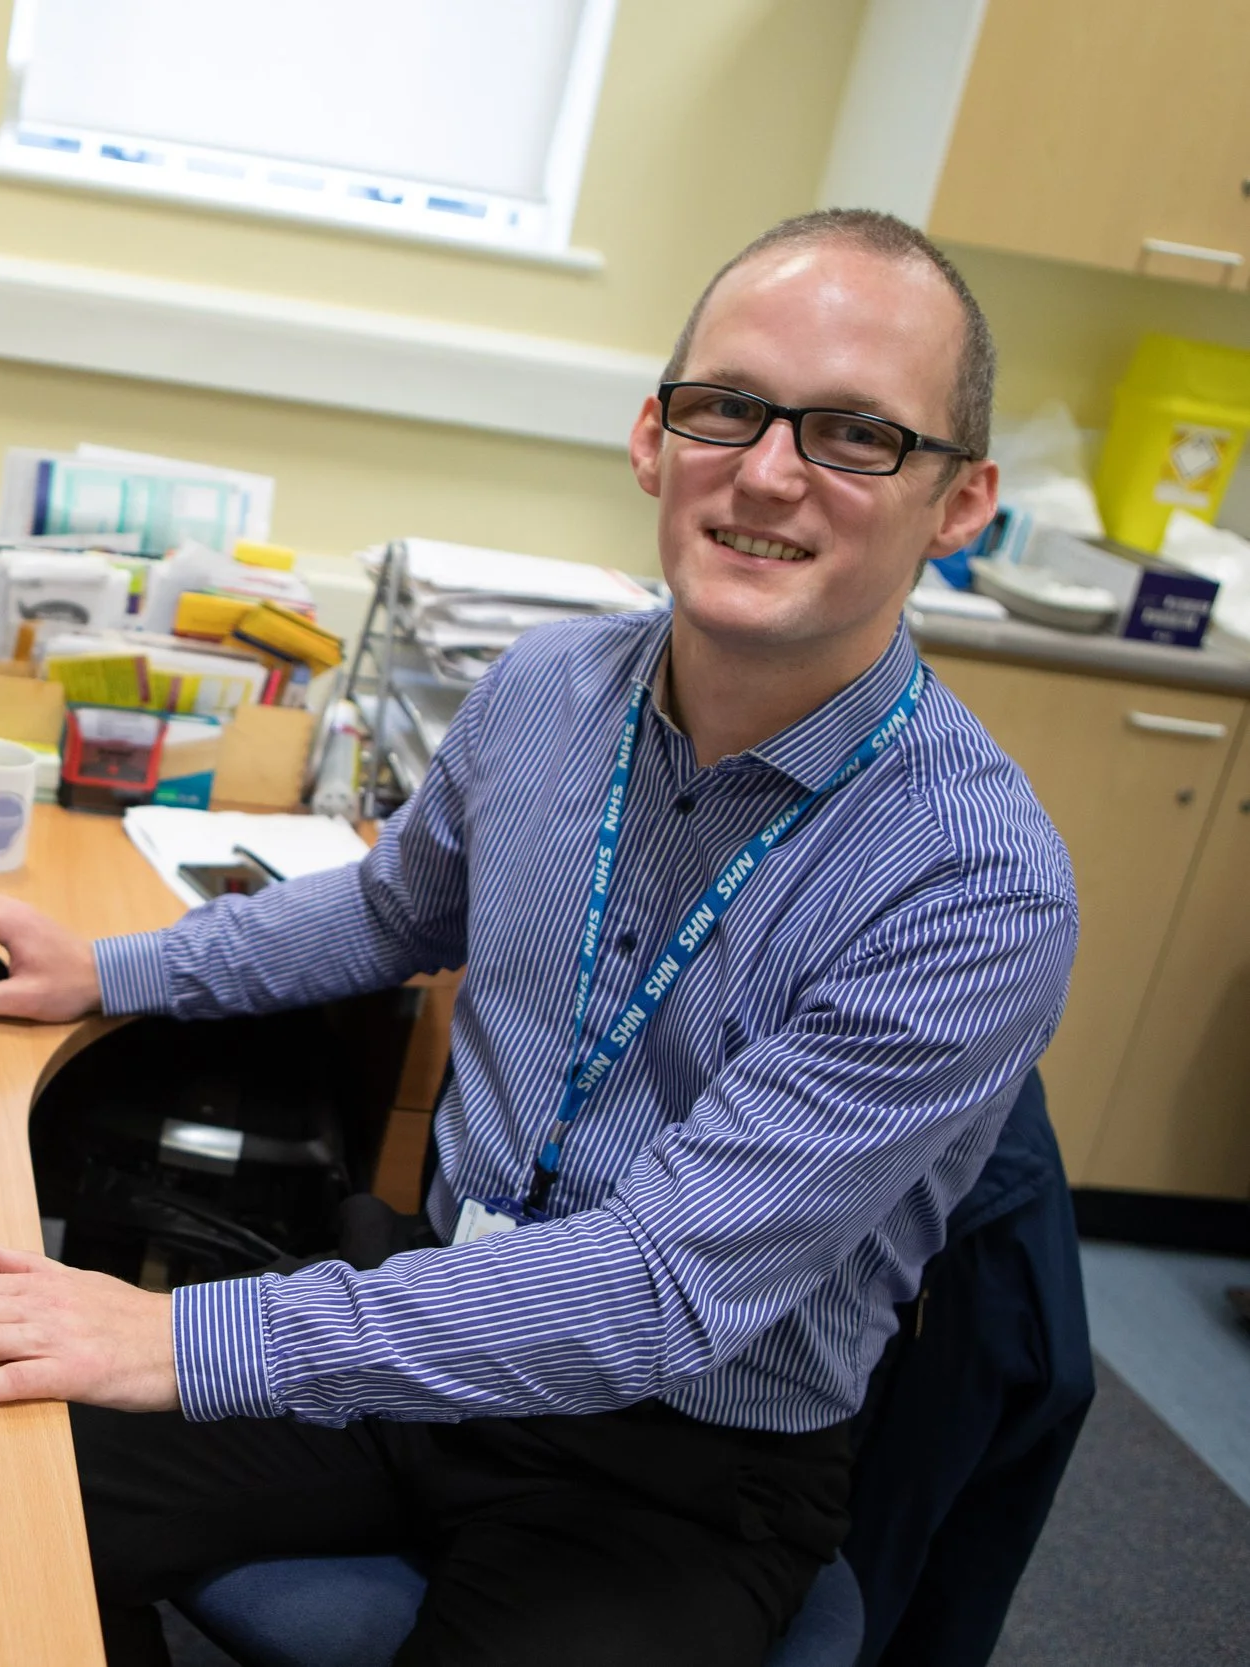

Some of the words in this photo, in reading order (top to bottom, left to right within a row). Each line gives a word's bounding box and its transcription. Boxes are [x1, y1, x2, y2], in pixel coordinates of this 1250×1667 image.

[871, 706, 909, 753] NHS
[760, 804, 799, 847] NHS
[575, 971, 589, 1019] NHS
[584, 908, 600, 957] NHS
[595, 845, 612, 894] NHS
[604, 784, 624, 831] NHS
[617, 723, 635, 769] NHS
[716, 851, 755, 900] NHS
[678, 903, 715, 952] NHS
[645, 954, 680, 1001] NHS
[610, 1003, 646, 1048] NHS
[577, 1052, 612, 1092] NHS
